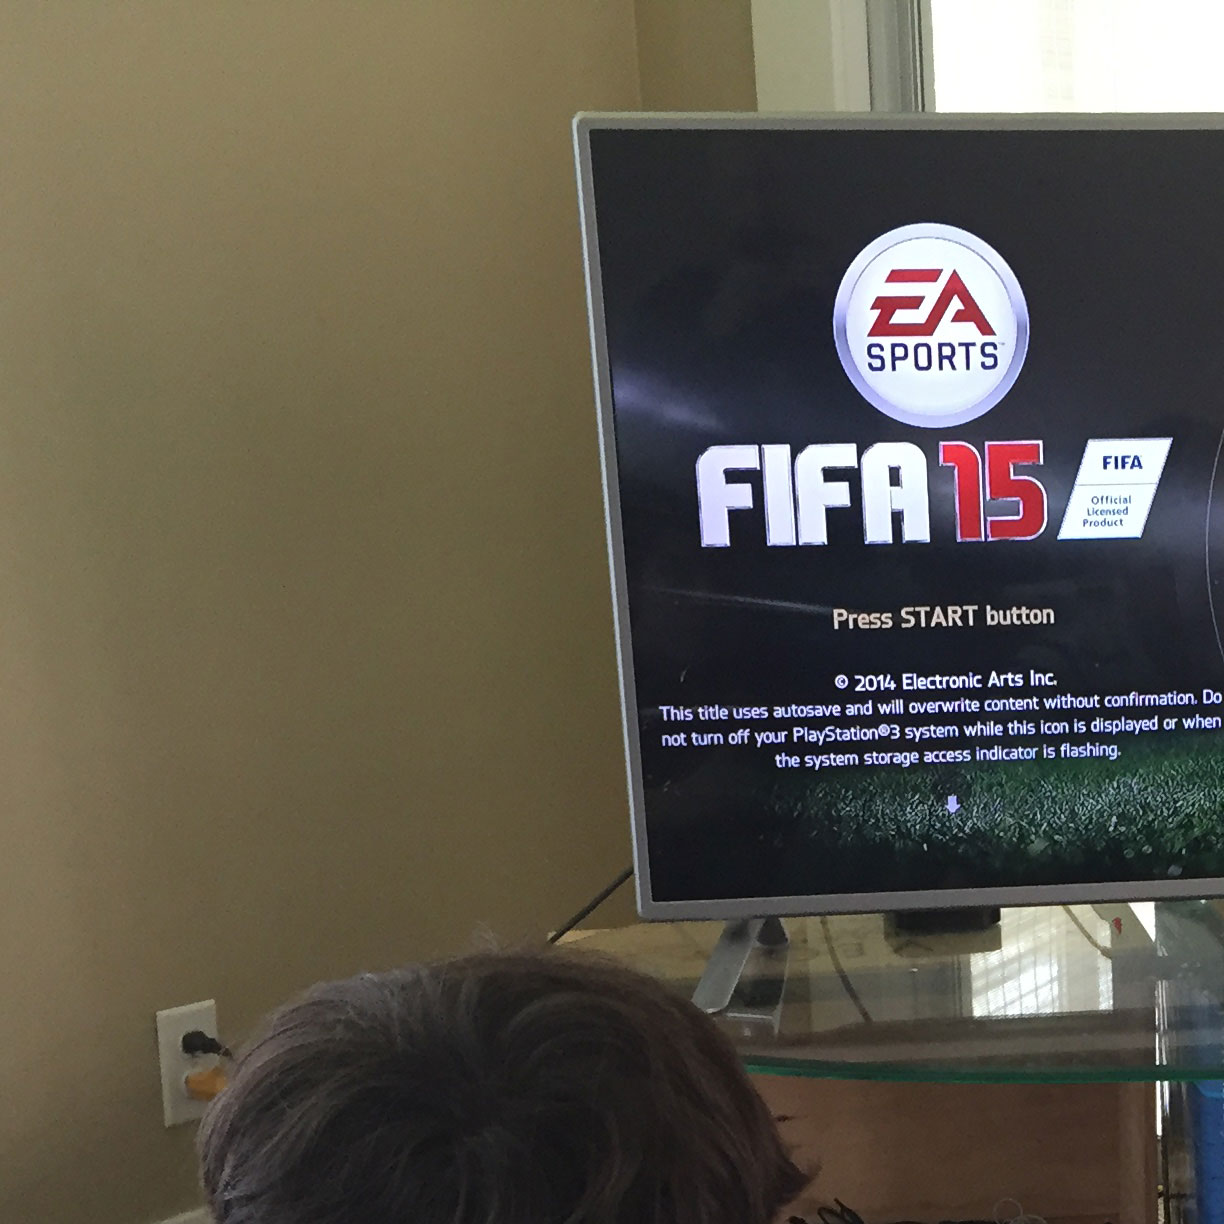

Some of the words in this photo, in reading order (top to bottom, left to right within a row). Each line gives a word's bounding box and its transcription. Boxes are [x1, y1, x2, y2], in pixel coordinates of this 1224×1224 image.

[867, 269, 998, 337] EA
[867, 342, 998, 372] SPORTS
[1102, 455, 1143, 470] FIFA
[696, 442, 931, 548] FIFA
[938, 440, 1047, 542] 15
[1091, 495, 1132, 505] Official
[1083, 518, 1124, 528] Product
[1087, 506, 1129, 516] Licensed
[832, 608, 893, 629] Press
[900, 605, 978, 628] START
[986, 605, 1055, 626] button
[854, 673, 896, 691] 2014
[902, 671, 982, 690] Electronic
[988, 670, 1023, 687] Arts
[1030, 669, 1057, 687] Inc.
[659, 705, 693, 721] This
[698, 704, 728, 720] title
[733, 706, 768, 719] uses
[773, 703, 841, 718] autosave
[846, 699, 872, 716] and
[877, 698, 903, 715] will
[908, 698, 980, 714] overwrite
[984, 696, 1039, 711] content
[1043, 693, 1100, 710] without
[1104, 690, 1197, 708] confirmation.
[1202, 688, 1222, 705] Do
[661, 732, 687, 747] not
[691, 731, 724, 746] turn
[728, 728, 750, 744] off
[754, 730, 788, 747] your
[904, 724, 959, 744] system
[963, 721, 1003, 737] while
[1007, 719, 1036, 735] this
[1040, 718, 1069, 734] icon
[1073, 717, 1087, 733] is
[1090, 714, 1158, 735] displayed
[1163, 717, 1178, 730] or
[1182, 713, 1222, 729] when
[775, 752, 800, 768] the
[804, 752, 859, 770] system
[864, 749, 919, 767] storage
[923, 748, 971, 763] access
[975, 745, 1038, 761] indicator
[1043, 743, 1055, 759] is
[1060, 741, 1121, 760] flashing.
